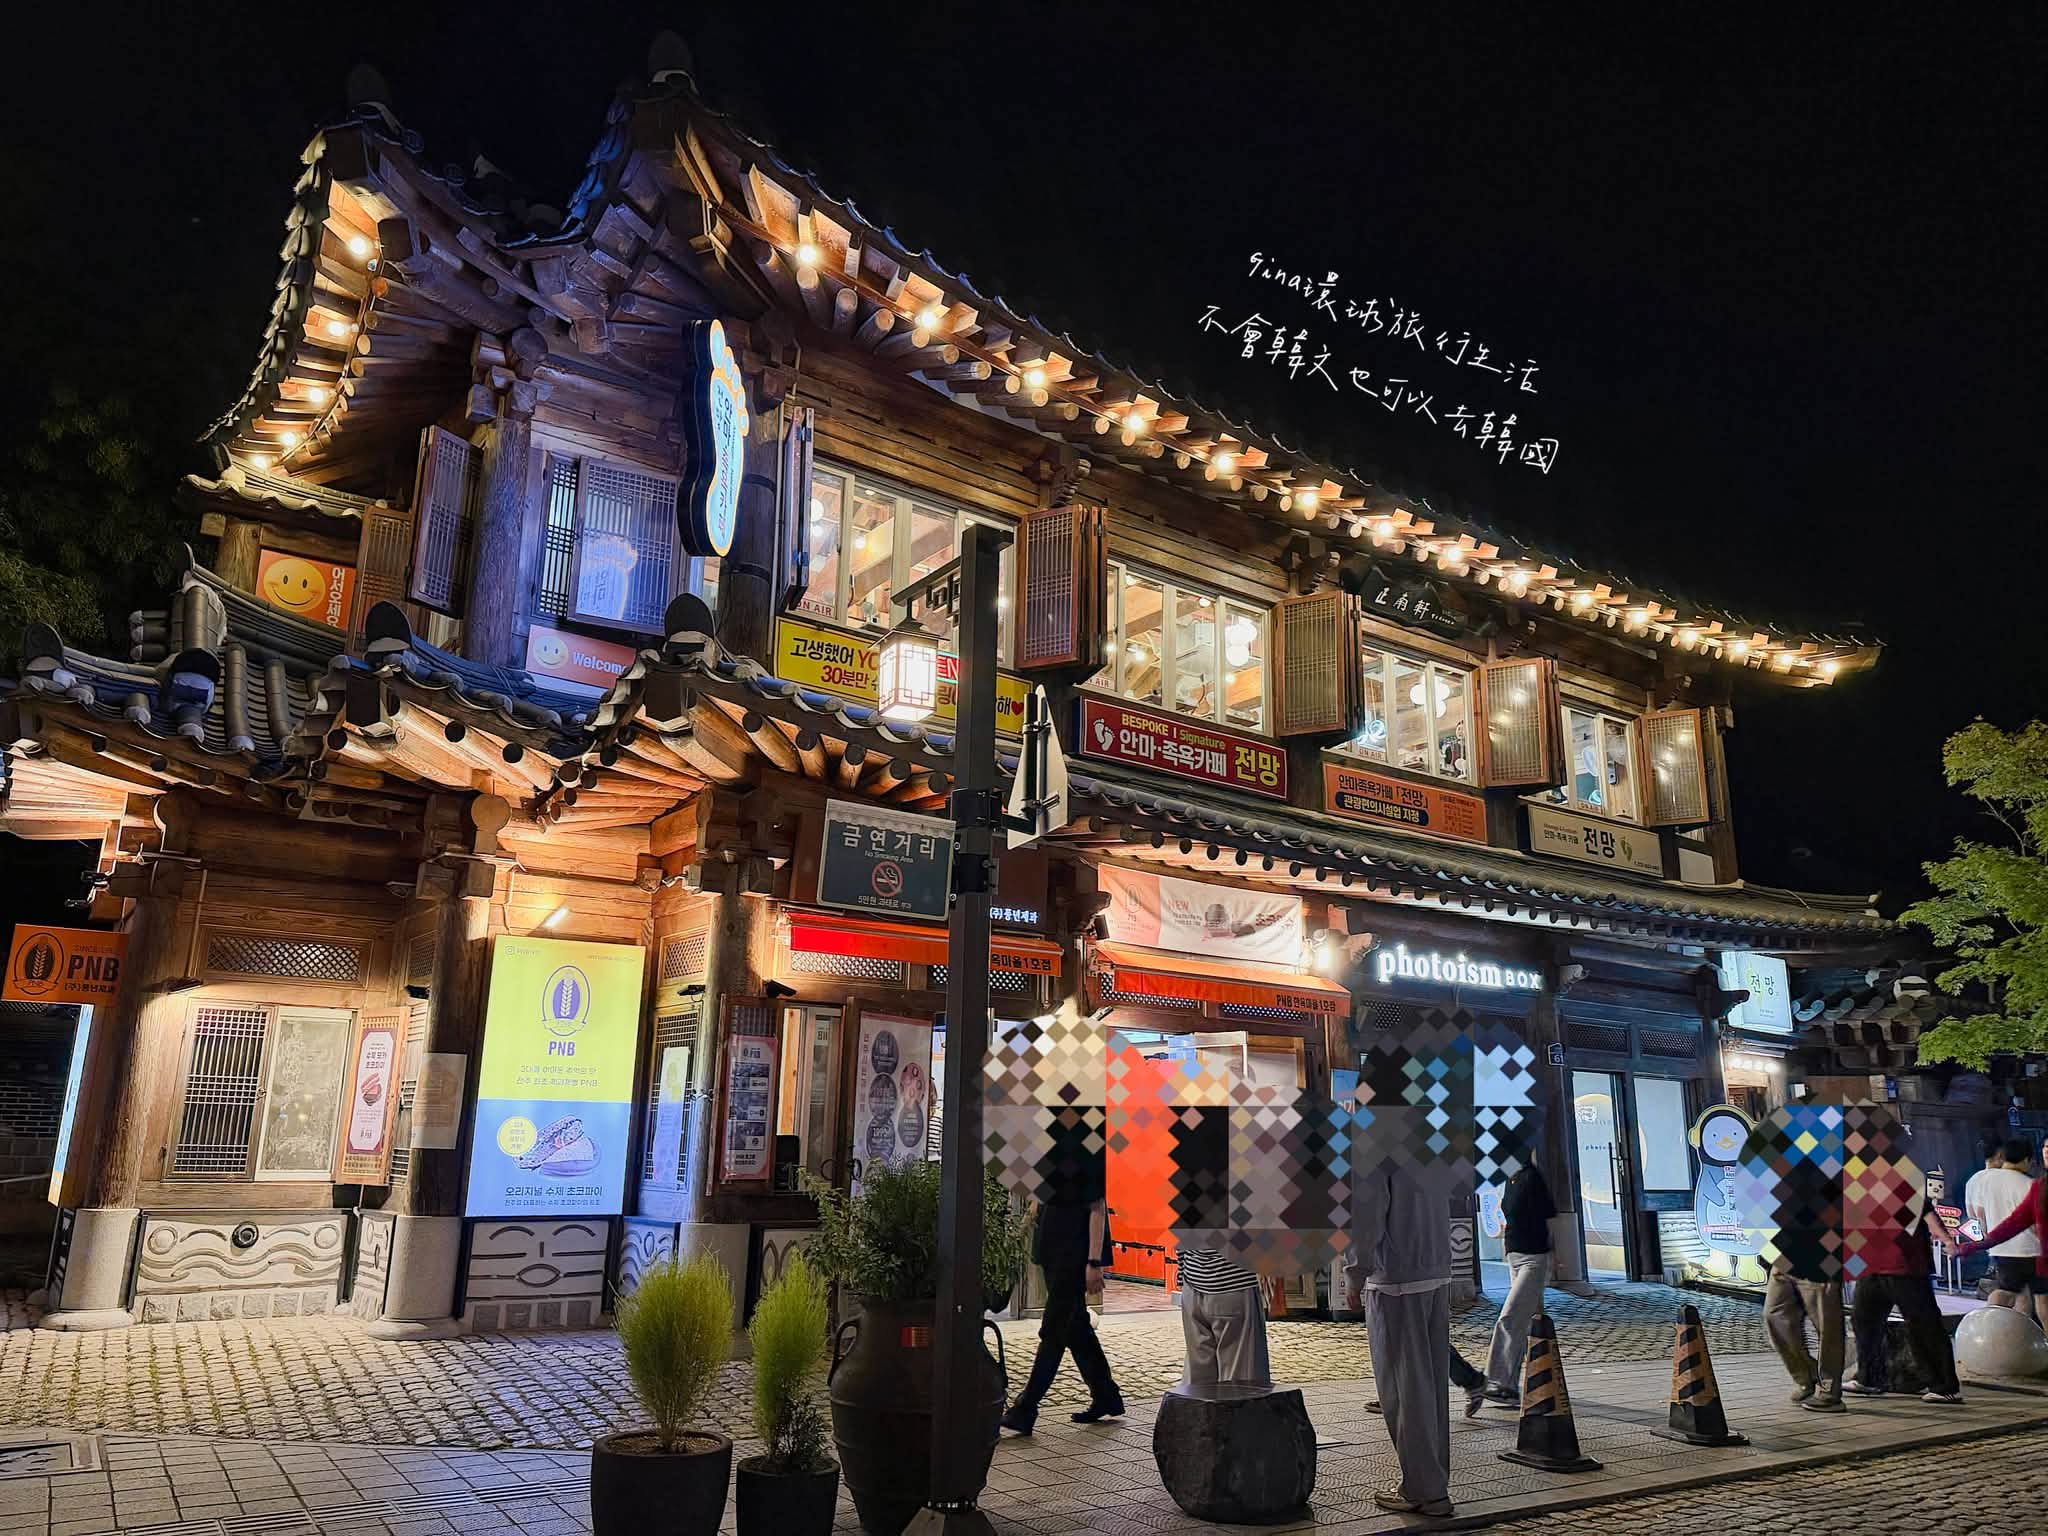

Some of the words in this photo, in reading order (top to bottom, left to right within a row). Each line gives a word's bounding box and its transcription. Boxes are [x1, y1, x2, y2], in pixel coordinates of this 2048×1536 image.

[814, 604, 832, 616] AIR
[790, 637, 855, 667] 고생했어
[820, 664, 870, 690] 30분만
[1121, 713, 1169, 736] BESPOKE
[1179, 729, 1226, 750] Signature
[1233, 745, 1281, 787] 전망
[1343, 793, 1401, 819] 관광편의시설업
[1402, 807, 1421, 823] 지정
[842, 824, 936, 860] 금연거리
[1583, 825, 1617, 859] 전망
[864, 850, 874, 858] No
[899, 855, 914, 864] Area
[67, 954, 120, 982] PNB
[990, 953, 1052, 971] 옥마을1호점
[1379, 942, 1503, 987] photoism
[1750, 974, 1775, 996] 전망
[548, 1039, 576, 1057] PNB
[505, 1186, 543, 1197] 오리지널
[545, 1186, 564, 1197] 수제
[566, 1186, 603, 1197] 초코파이
